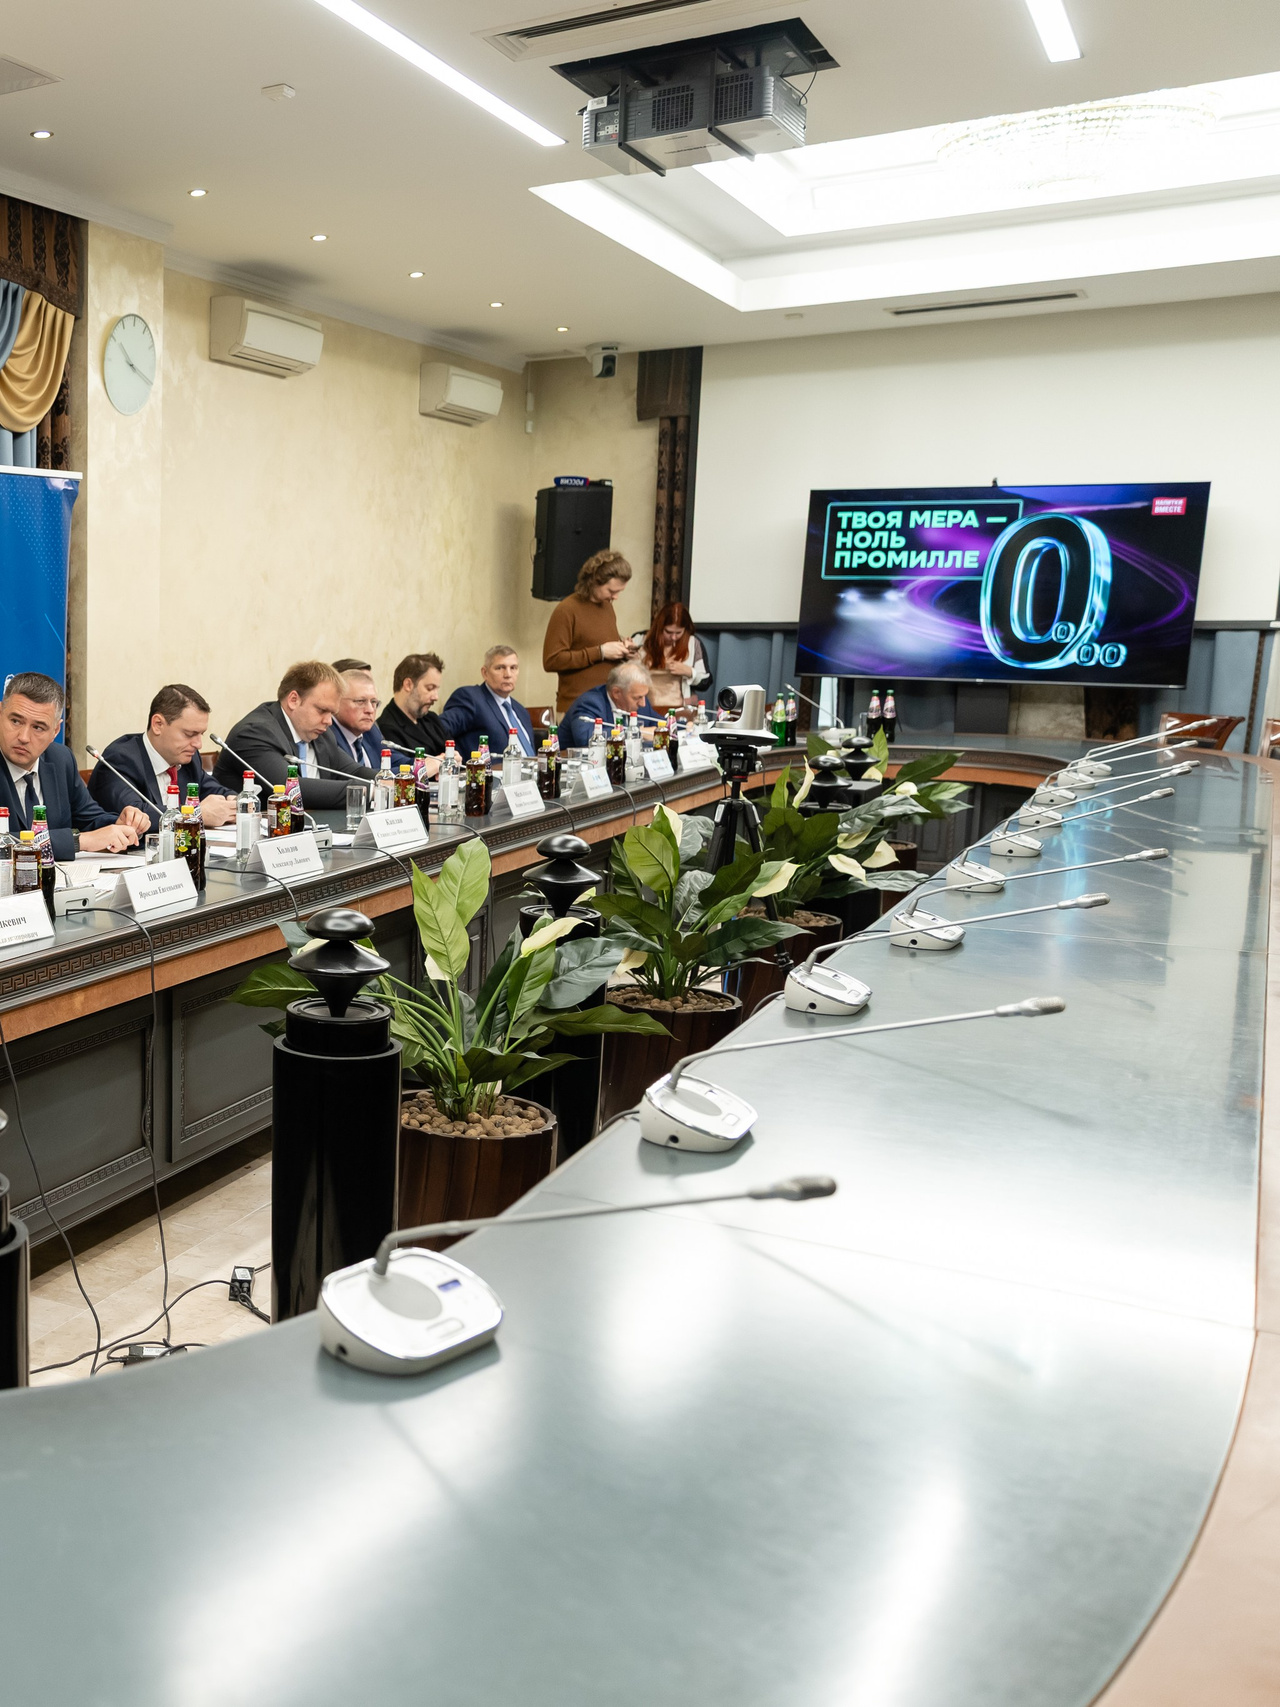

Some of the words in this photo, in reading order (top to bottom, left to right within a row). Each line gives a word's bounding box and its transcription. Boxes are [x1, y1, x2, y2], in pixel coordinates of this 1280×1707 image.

[837, 510, 903, 529] ТВОЯ
[909, 510, 980, 528] МЕРА
[835, 531, 907, 549] НОЛЬ
[834, 550, 980, 569] ПРОМИЛЛЕ
